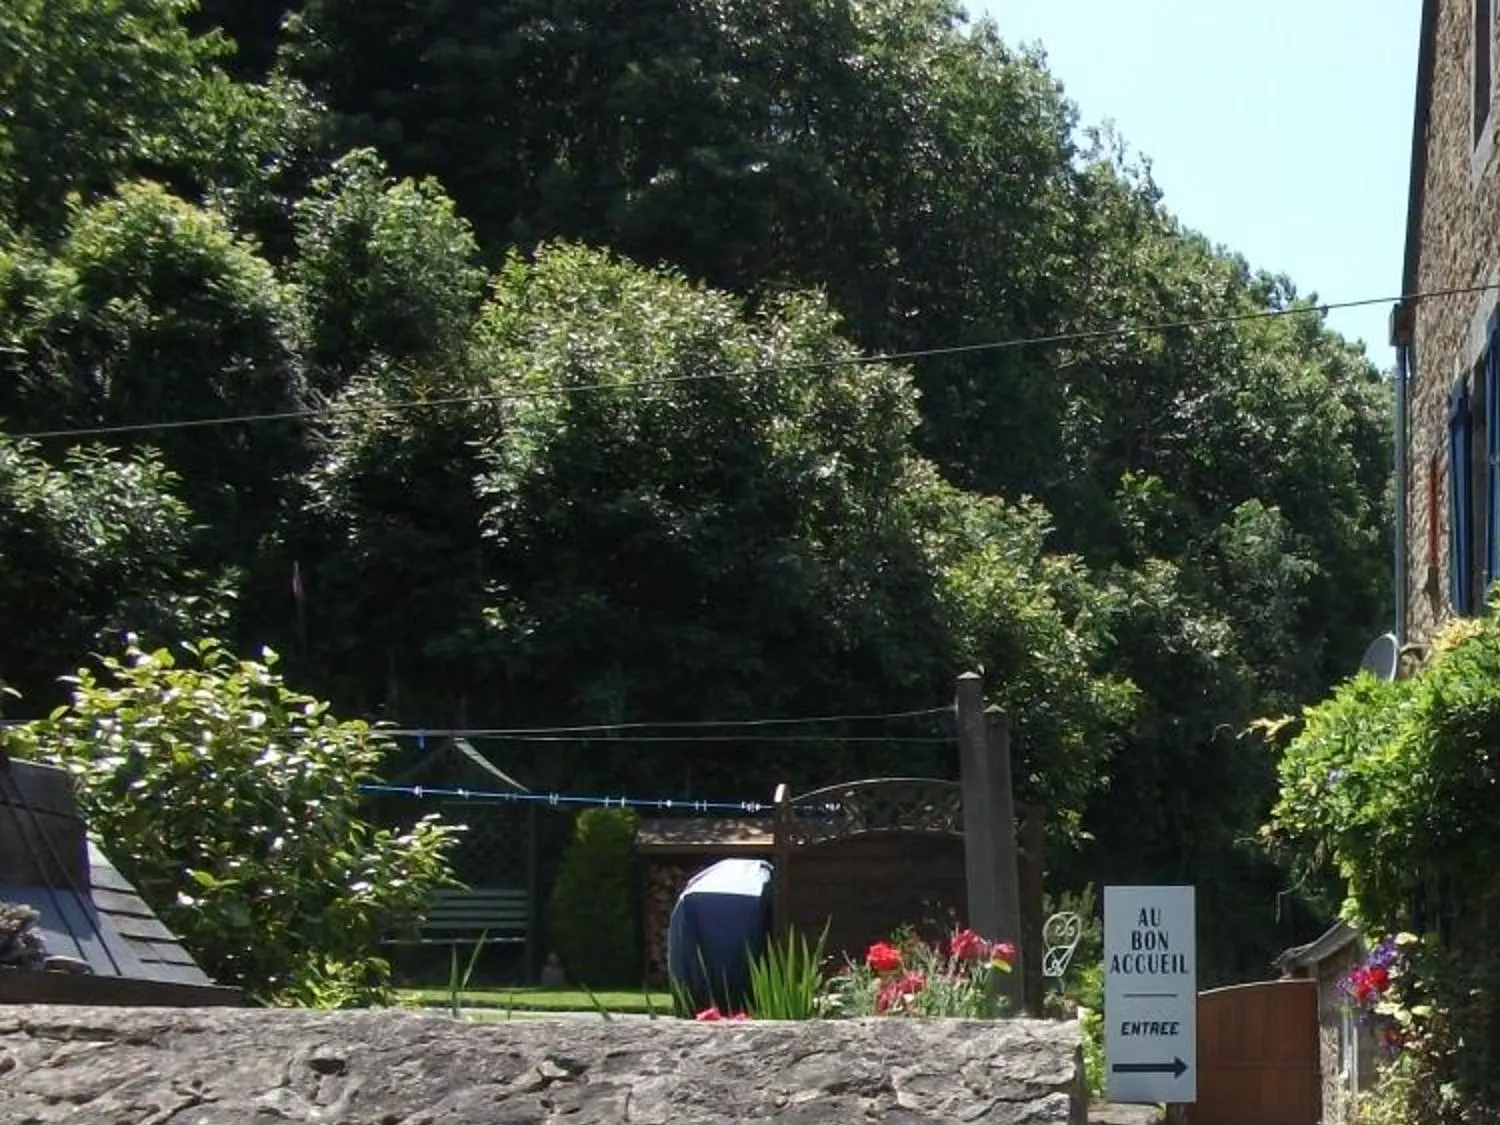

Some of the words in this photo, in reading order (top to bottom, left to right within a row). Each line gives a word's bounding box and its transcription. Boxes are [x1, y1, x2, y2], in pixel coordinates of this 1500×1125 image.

[1137, 907, 1160, 928] AU
[1131, 930, 1169, 951] BON
[1109, 953, 1189, 975] ACCUEIL
[1120, 1021, 1180, 1037] ENTREE
